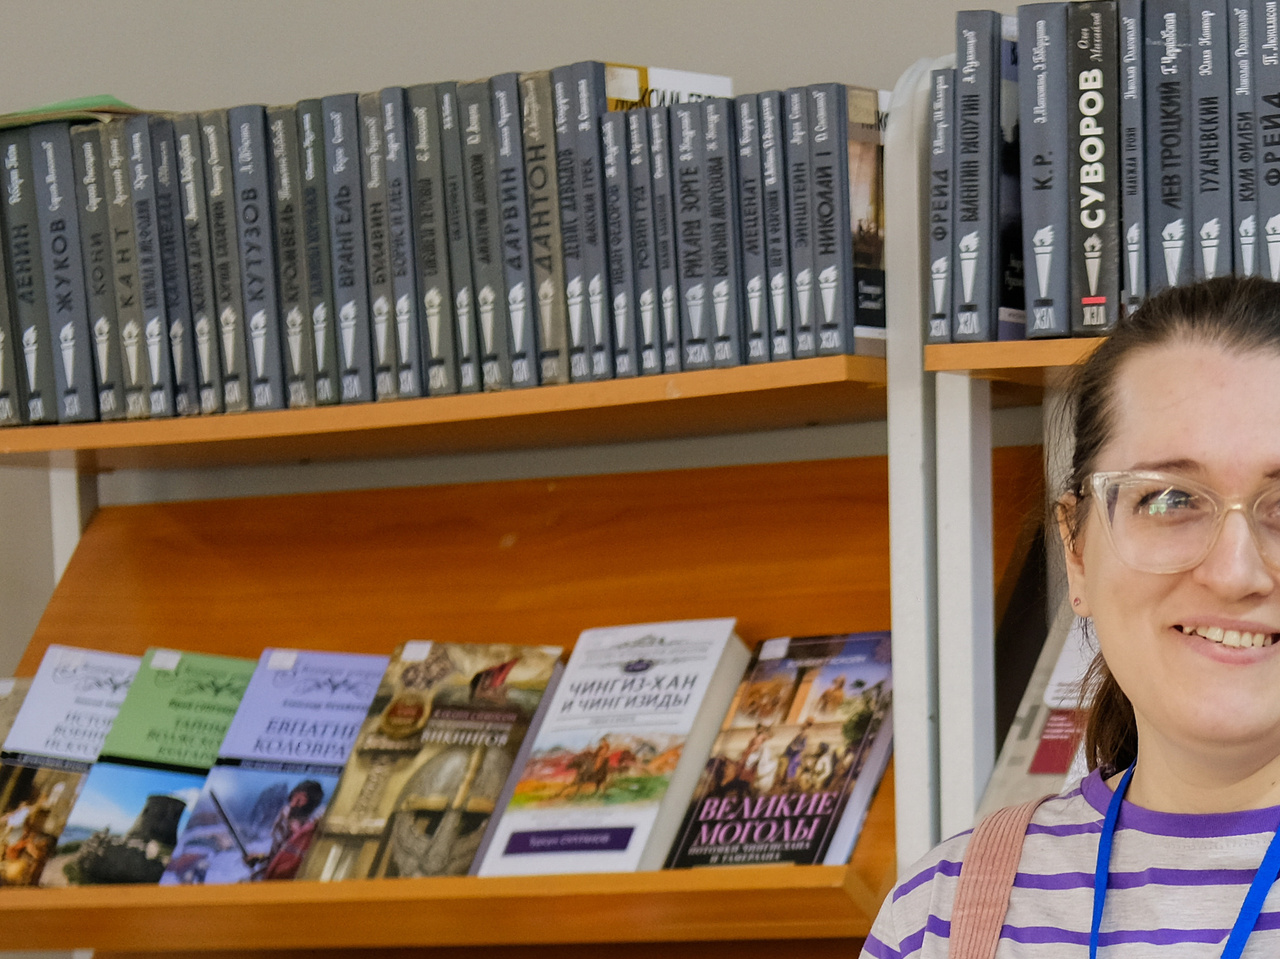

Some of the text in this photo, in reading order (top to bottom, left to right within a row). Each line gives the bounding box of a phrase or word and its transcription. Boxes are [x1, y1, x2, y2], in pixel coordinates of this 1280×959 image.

[679, 165, 702, 216] ЗОРГЕ
[1078, 68, 1107, 229] СУВОРОВ
[1157, 81, 1183, 210] ЛЕВ ТРОЦКИЙ
[1198, 95, 1220, 194] ТУХАЧЕВСКИЙ
[1237, 111, 1255, 203] КИМ ФИЛБИ
[241, 187, 266, 302] КУТУЗОВ
[500, 166, 523, 271] ДАРВИН
[527, 143, 553, 274] ДАНТОН
[815, 165, 838, 257] НИКОЛАЙ
[50, 218, 73, 314] ЖУКОВ
[114, 228, 134, 308] КАНТ
[560, 693, 692, 714] И ЧИНГИЗИДЫ
[569, 673, 700, 695] ЧИНГИЗ-ХАН
[692, 816, 821, 846] МОГОЛЫ
[698, 791, 838, 823] ВЕЛИКИЕ
